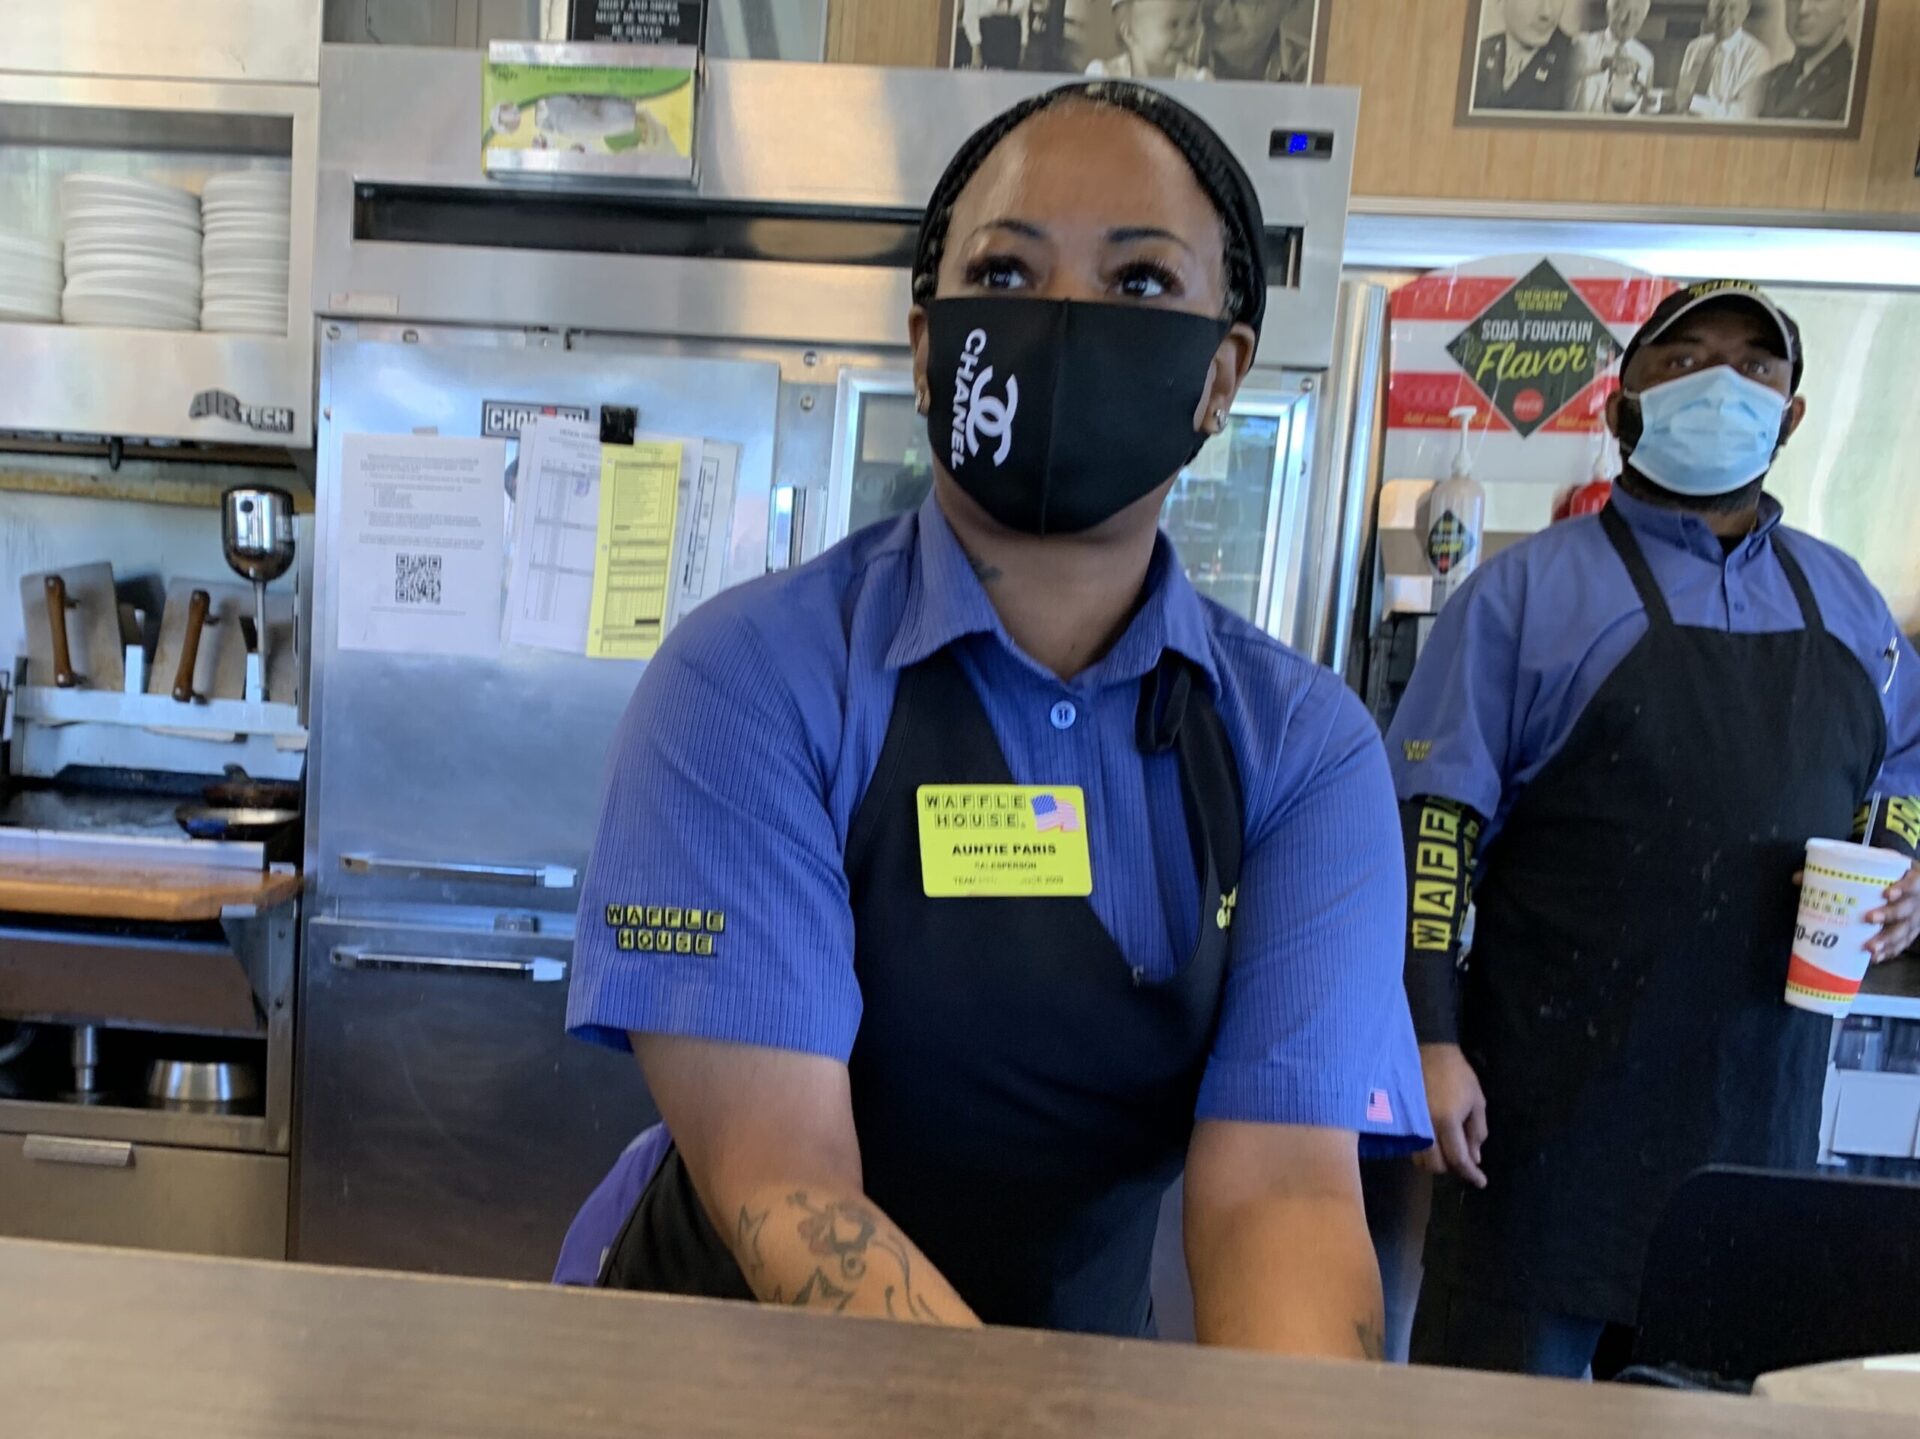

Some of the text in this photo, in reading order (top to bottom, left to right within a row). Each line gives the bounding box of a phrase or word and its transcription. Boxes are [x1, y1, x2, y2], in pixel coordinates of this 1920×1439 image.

[1481, 319, 1593, 343] SODA FOUNTAIN
[1475, 341, 1588, 383] Flavor
[952, 328, 987, 470] CHANEL
[925, 794, 1026, 811] WAFFLE
[935, 813, 1020, 829] HOUSE
[951, 843, 1057, 856] AUNTIE PARIS
[607, 903, 724, 931] WAFFLE
[617, 928, 714, 955] HOUSE
